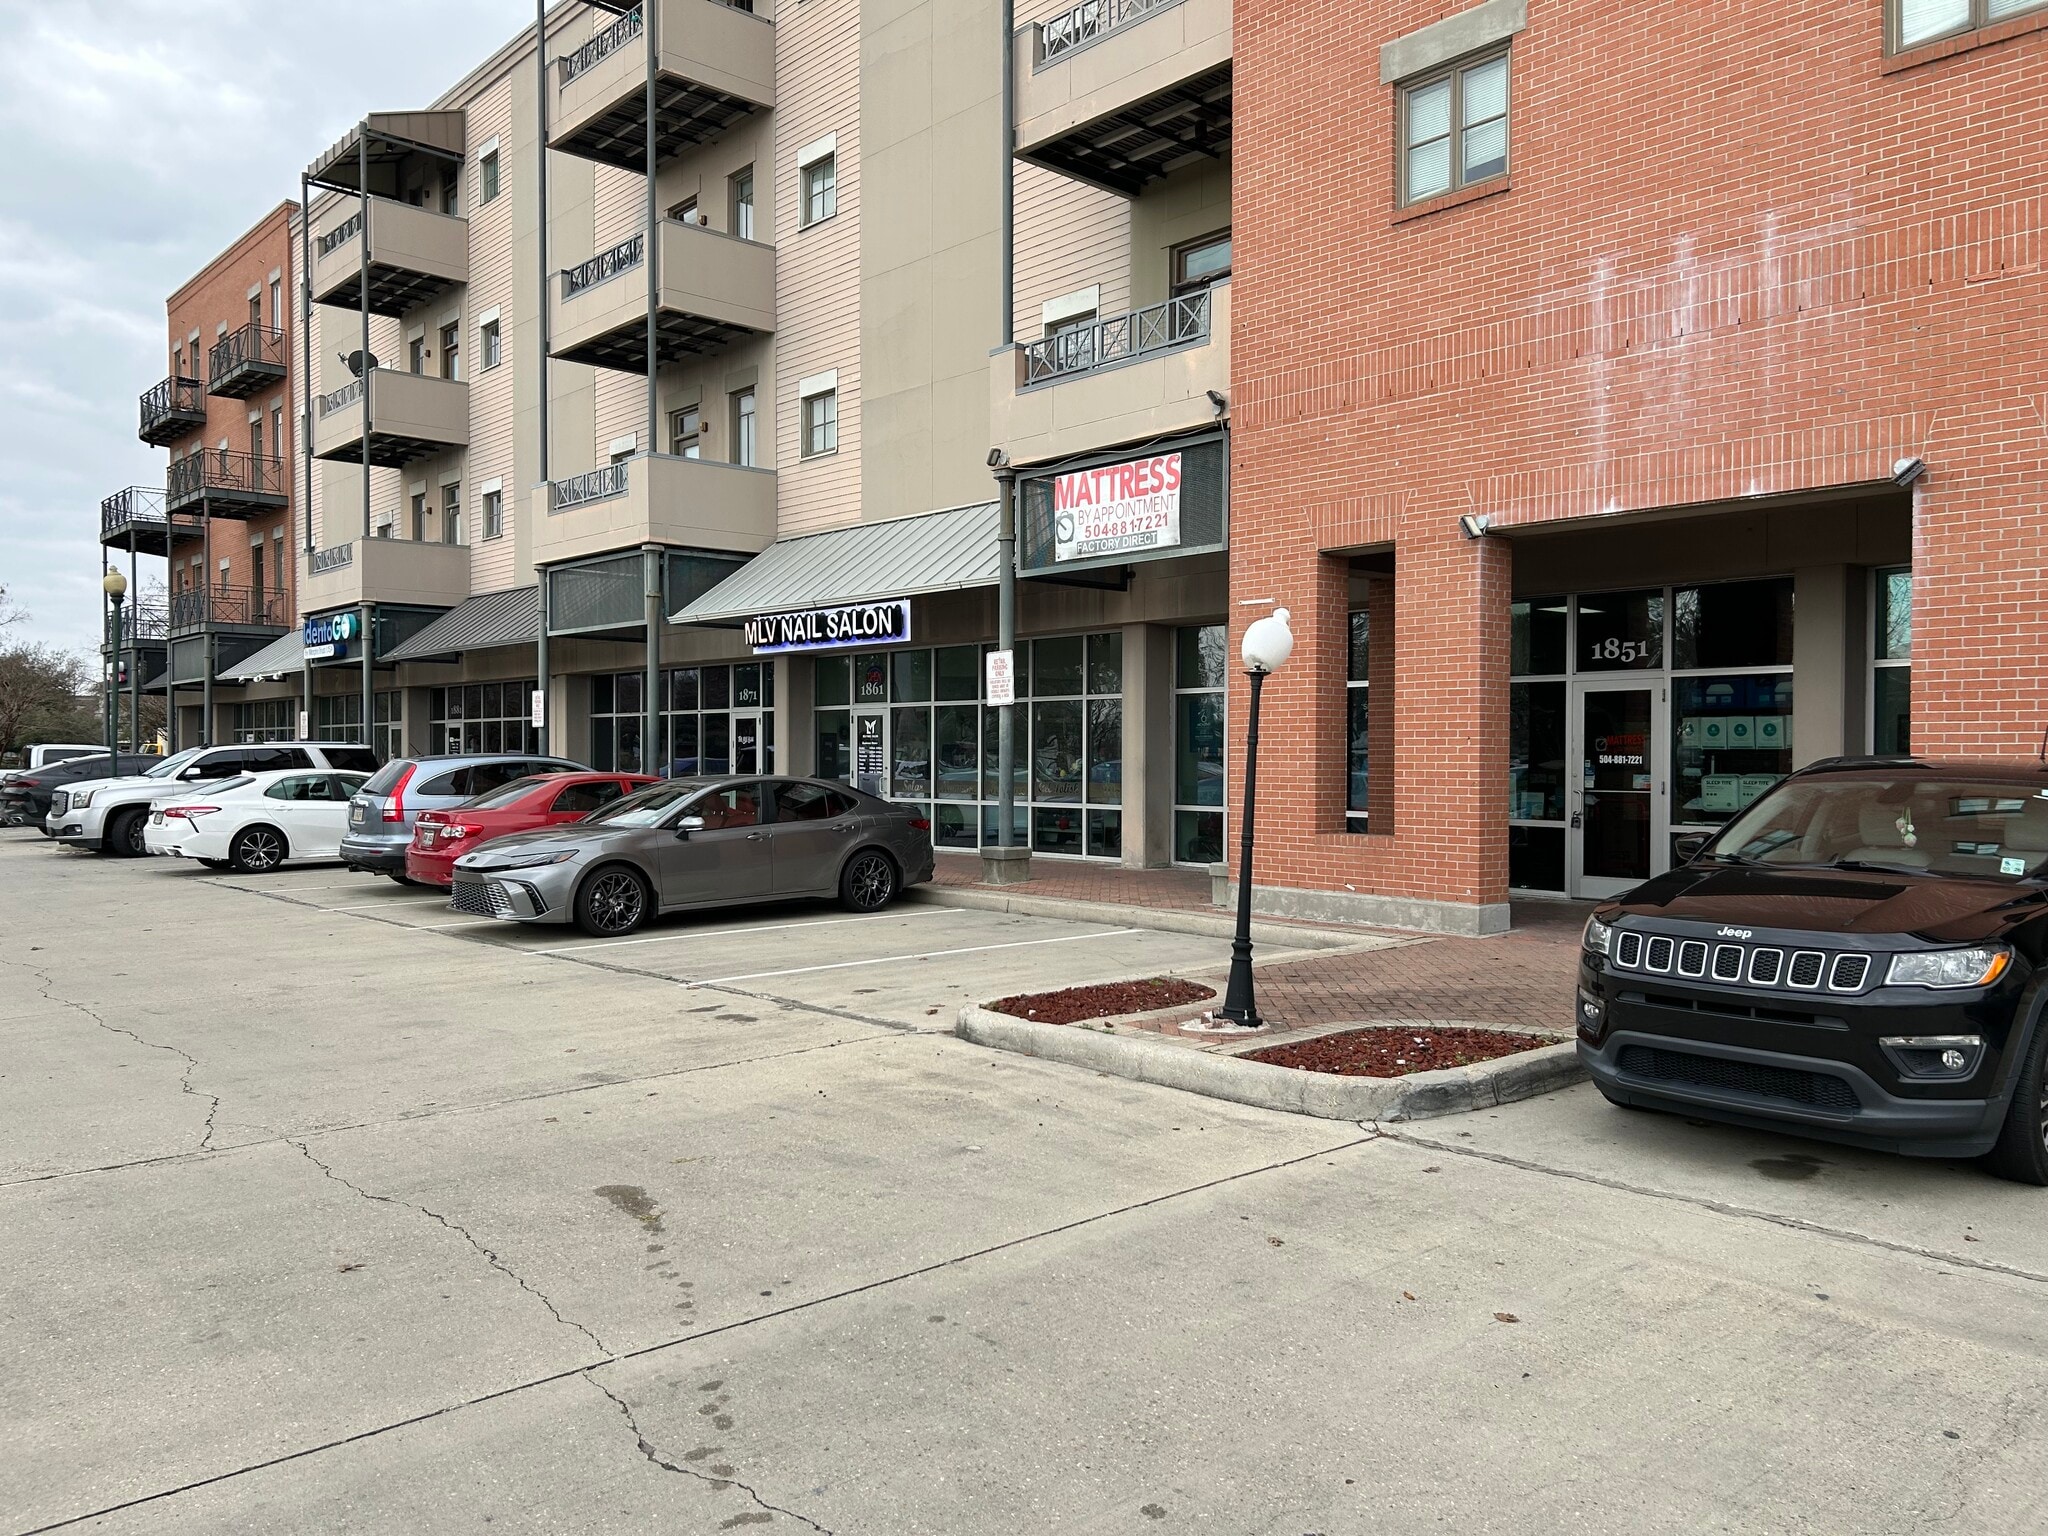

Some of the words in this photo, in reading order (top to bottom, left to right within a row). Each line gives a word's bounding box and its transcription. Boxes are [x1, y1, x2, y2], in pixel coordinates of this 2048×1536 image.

[1055, 454, 1181, 511] MATTRESS
[1078, 508, 1091, 526] BY
[1093, 493, 1176, 523] APPOINTMENT
[1077, 537, 1120, 553] FACTORY
[1122, 532, 1157, 547] DIRECT
[303, 613, 350, 645] IdentoGO
[744, 618, 776, 645] MLV
[781, 614, 822, 642] NAIL
[826, 607, 892, 639] SALON
[1591, 637, 1649, 662] 1851
[739, 688, 757, 703] 1871
[861, 682, 885, 696] 1861
[1599, 755, 1643, 765] 504-881-7221
[1717, 926, 1752, 940] Jeep
